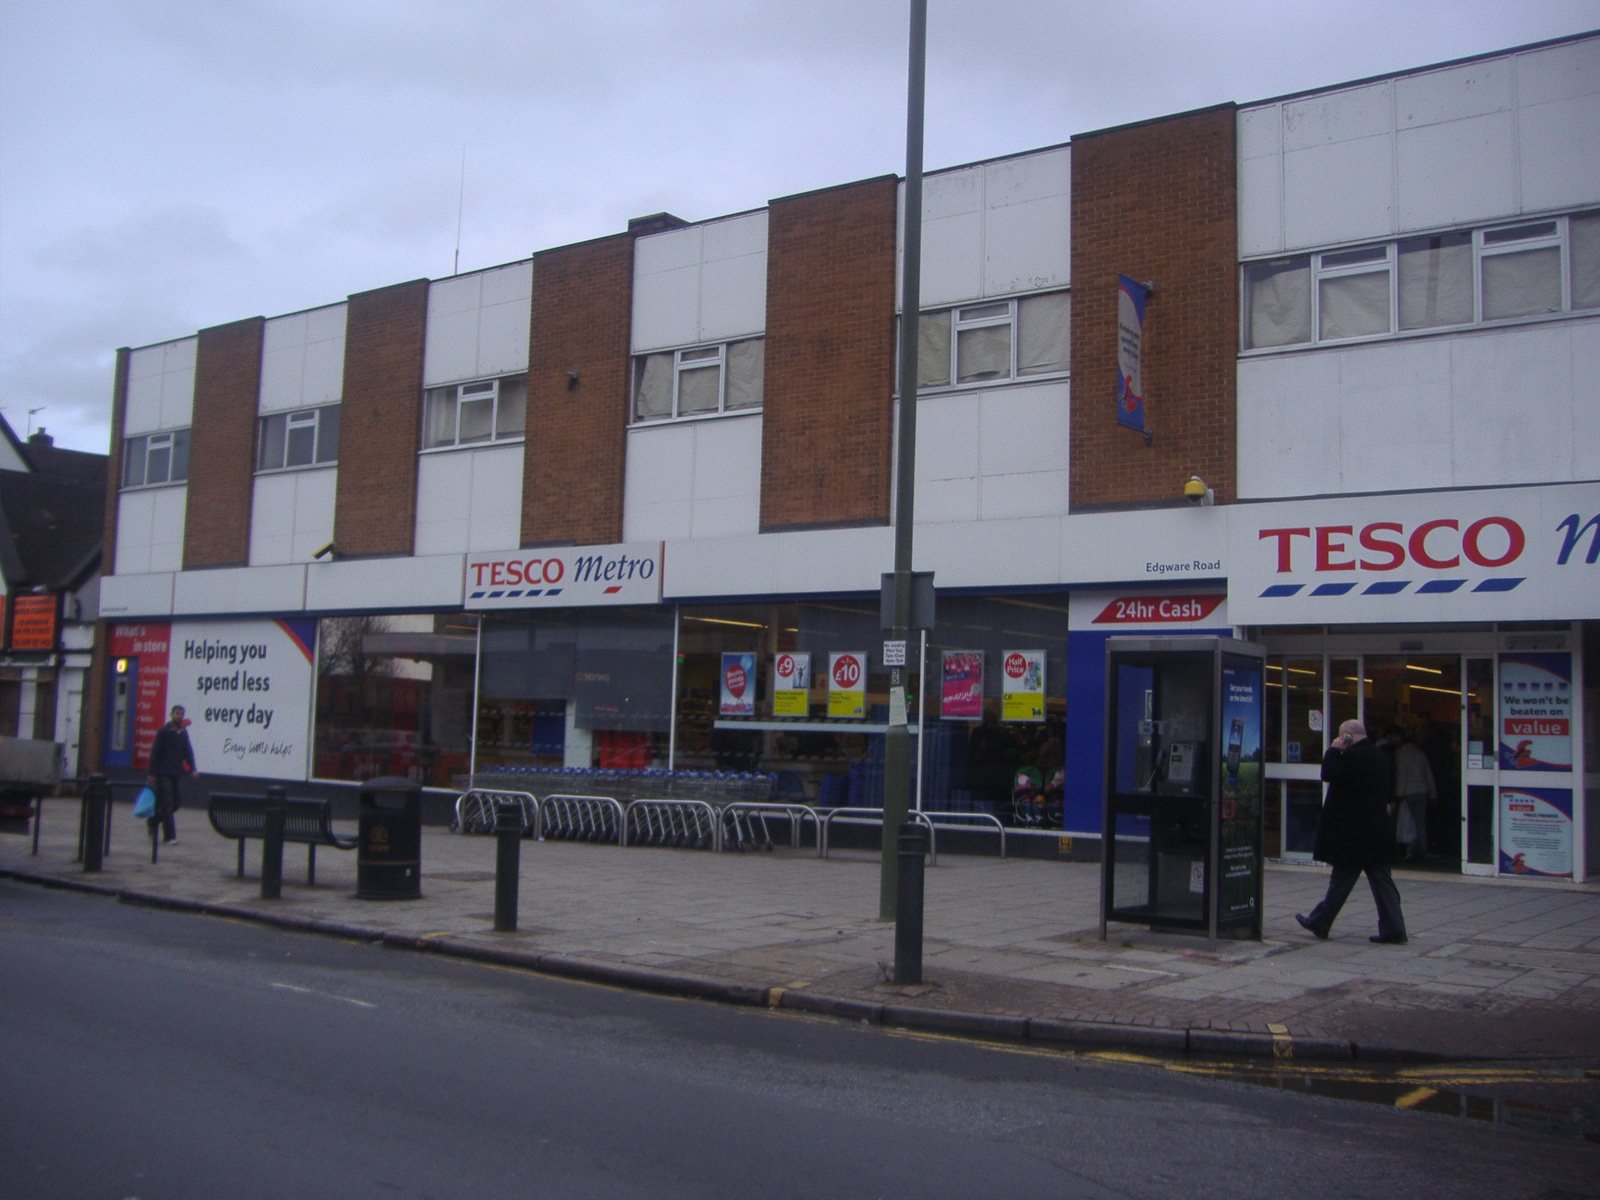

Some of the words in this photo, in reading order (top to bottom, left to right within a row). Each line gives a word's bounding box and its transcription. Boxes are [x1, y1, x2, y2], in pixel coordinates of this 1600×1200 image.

[1258, 516, 1526, 573] TESCO
[470, 558, 565, 586] TESCO
[574, 554, 655, 582] Metro
[1146, 562, 1190, 574] Edgware
[1193, 559, 1221, 571] Road
[1115, 601, 1155, 619] 24hr
[1158, 599, 1202, 618] Cash
[115, 624, 146, 638] What's
[132, 638, 142, 652] in
[143, 640, 168, 653] store
[184, 639, 237, 665] Helping
[239, 644, 267, 665] you
[778, 656, 793, 674] £9
[1008, 656, 1024, 666] Half
[835, 664, 859, 681] £10
[1006, 665, 1025, 675] Price
[196, 670, 239, 695] spend
[242, 670, 270, 692] less
[1003, 693, 1013, 701] Cif
[1504, 696, 1522, 705] We
[1523, 695, 1554, 705] won't
[1556, 696, 1569, 705] be
[204, 707, 244, 728] every
[246, 702, 273, 730] day
[1510, 707, 1548, 716] beaten
[1550, 708, 1563, 716] on
[1512, 719, 1562, 735] value
[223, 738, 246, 760] Every
[270, 741, 293, 758] helps
